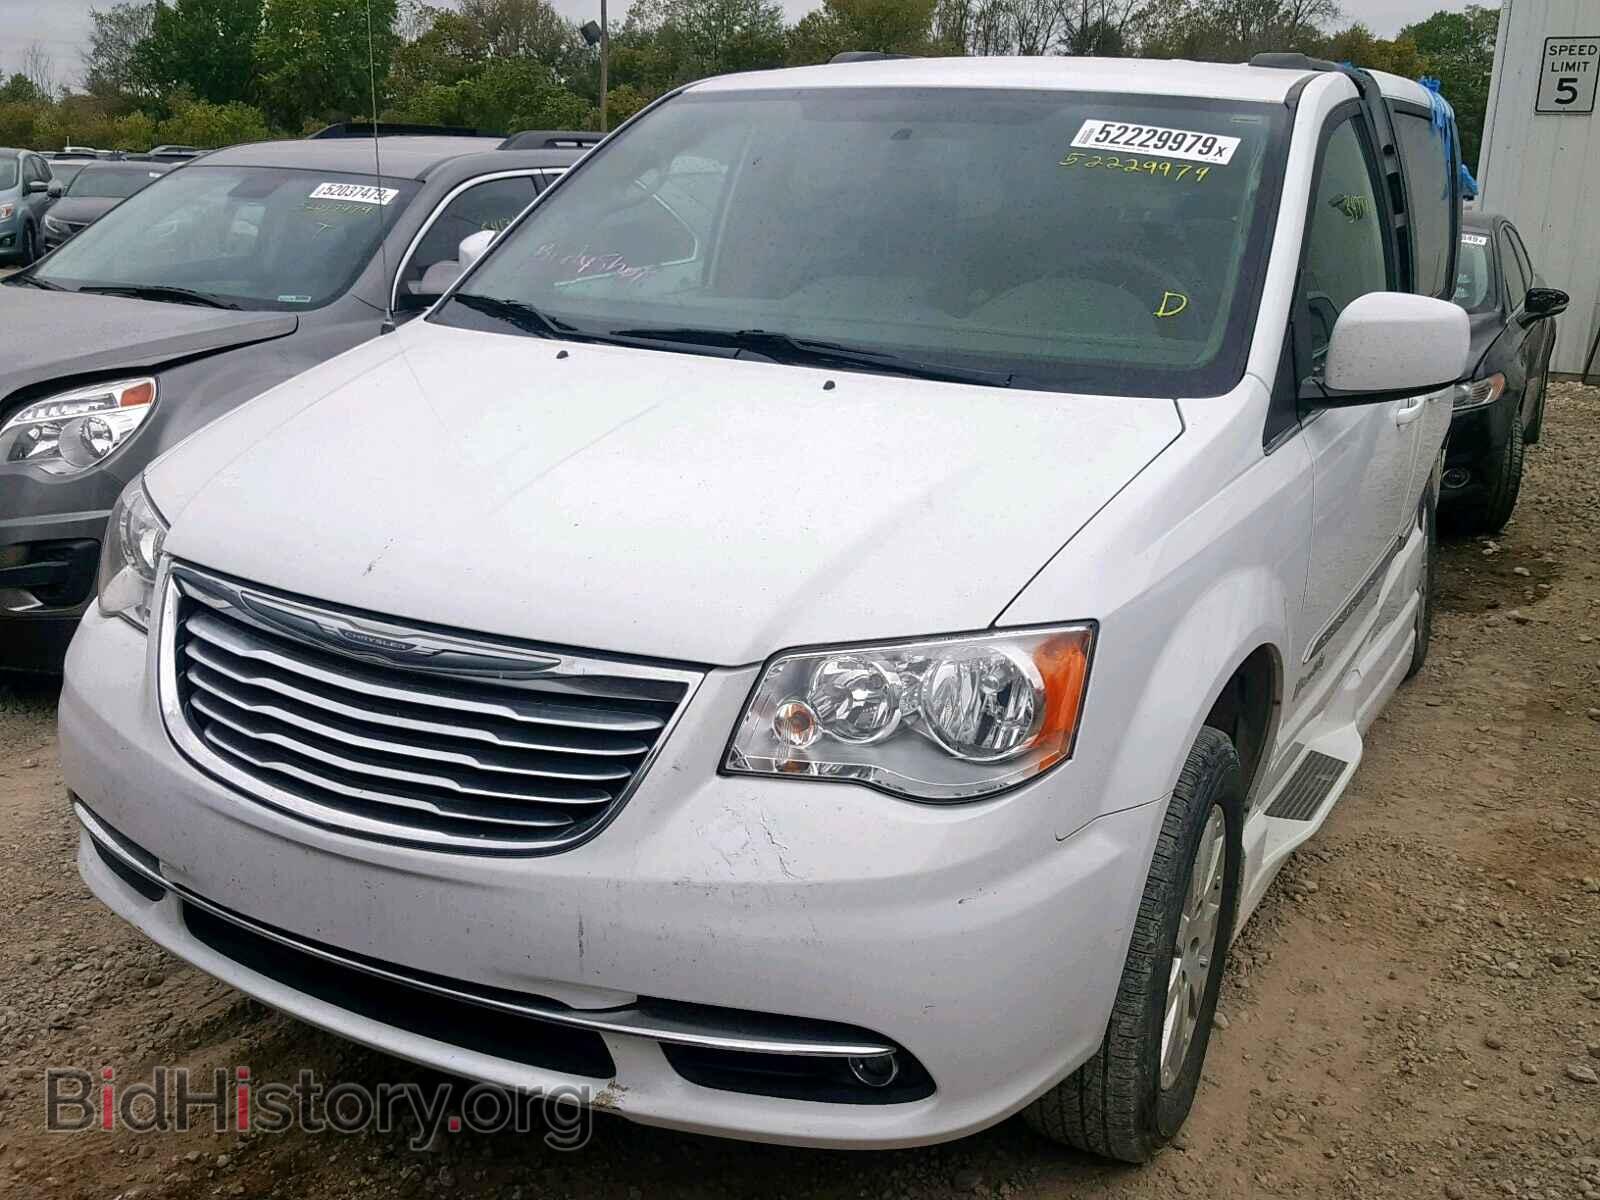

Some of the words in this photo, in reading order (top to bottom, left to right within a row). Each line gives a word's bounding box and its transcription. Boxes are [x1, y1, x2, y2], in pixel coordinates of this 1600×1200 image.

[1548, 44, 1598, 56] SPEED
[1551, 61, 1591, 73] LIMIT
[1554, 77, 1578, 105] 5
[1153, 291, 1188, 318] D
[344, 631, 408, 650] CHRYSLER
